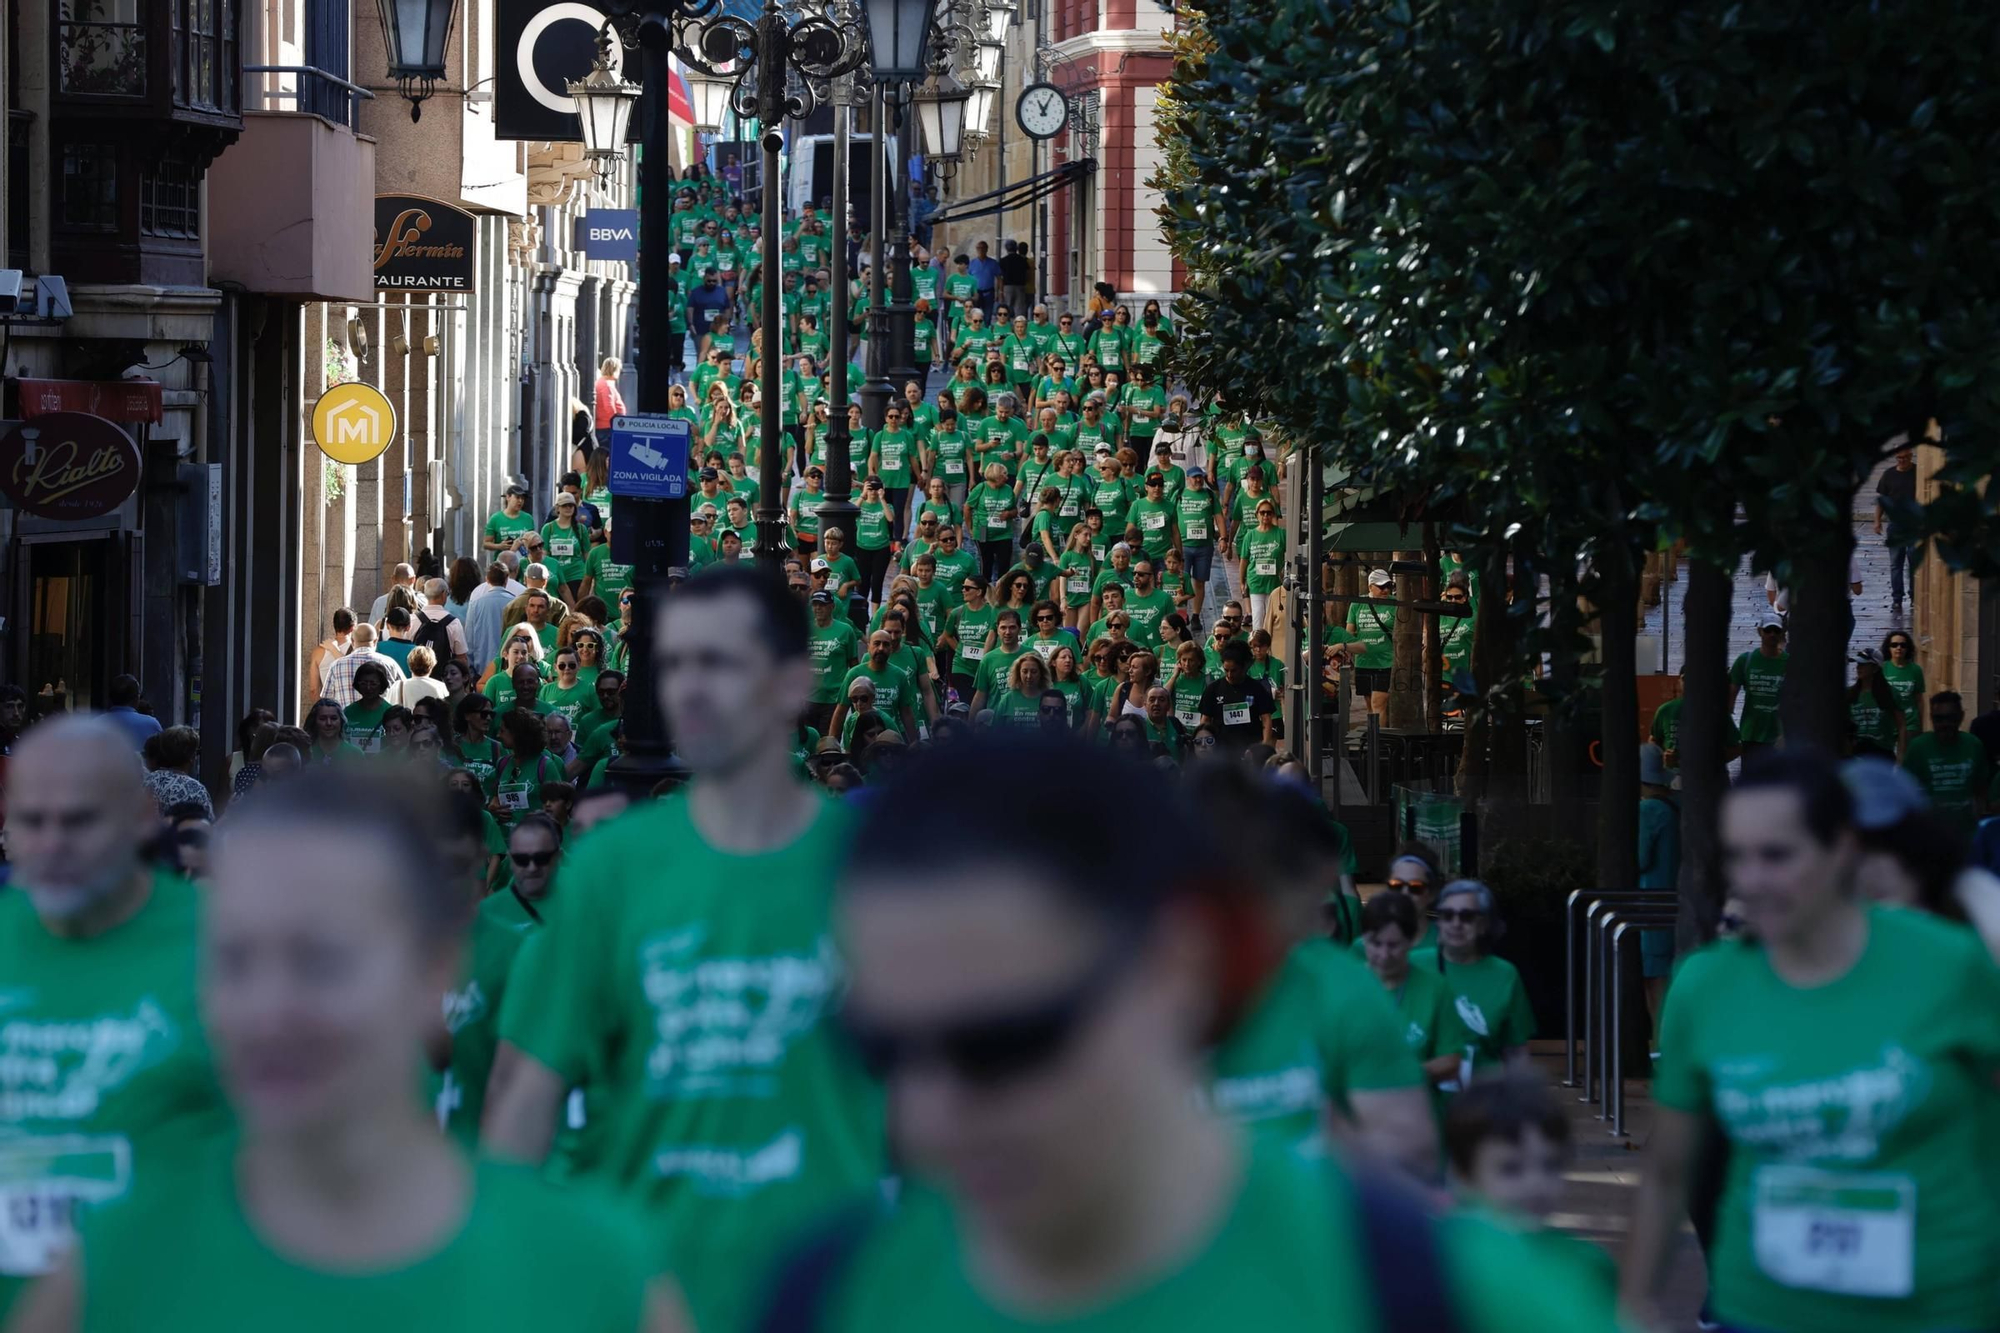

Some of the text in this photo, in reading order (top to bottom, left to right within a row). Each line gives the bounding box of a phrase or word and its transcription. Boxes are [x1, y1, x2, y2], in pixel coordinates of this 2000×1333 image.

[590, 228, 633, 241] BBVA
[12, 440, 125, 504] Rialto
[612, 471, 682, 482] ZONA VIGILADA
[1230, 710, 1244, 718] 1447
[506, 793, 519, 802] 985
